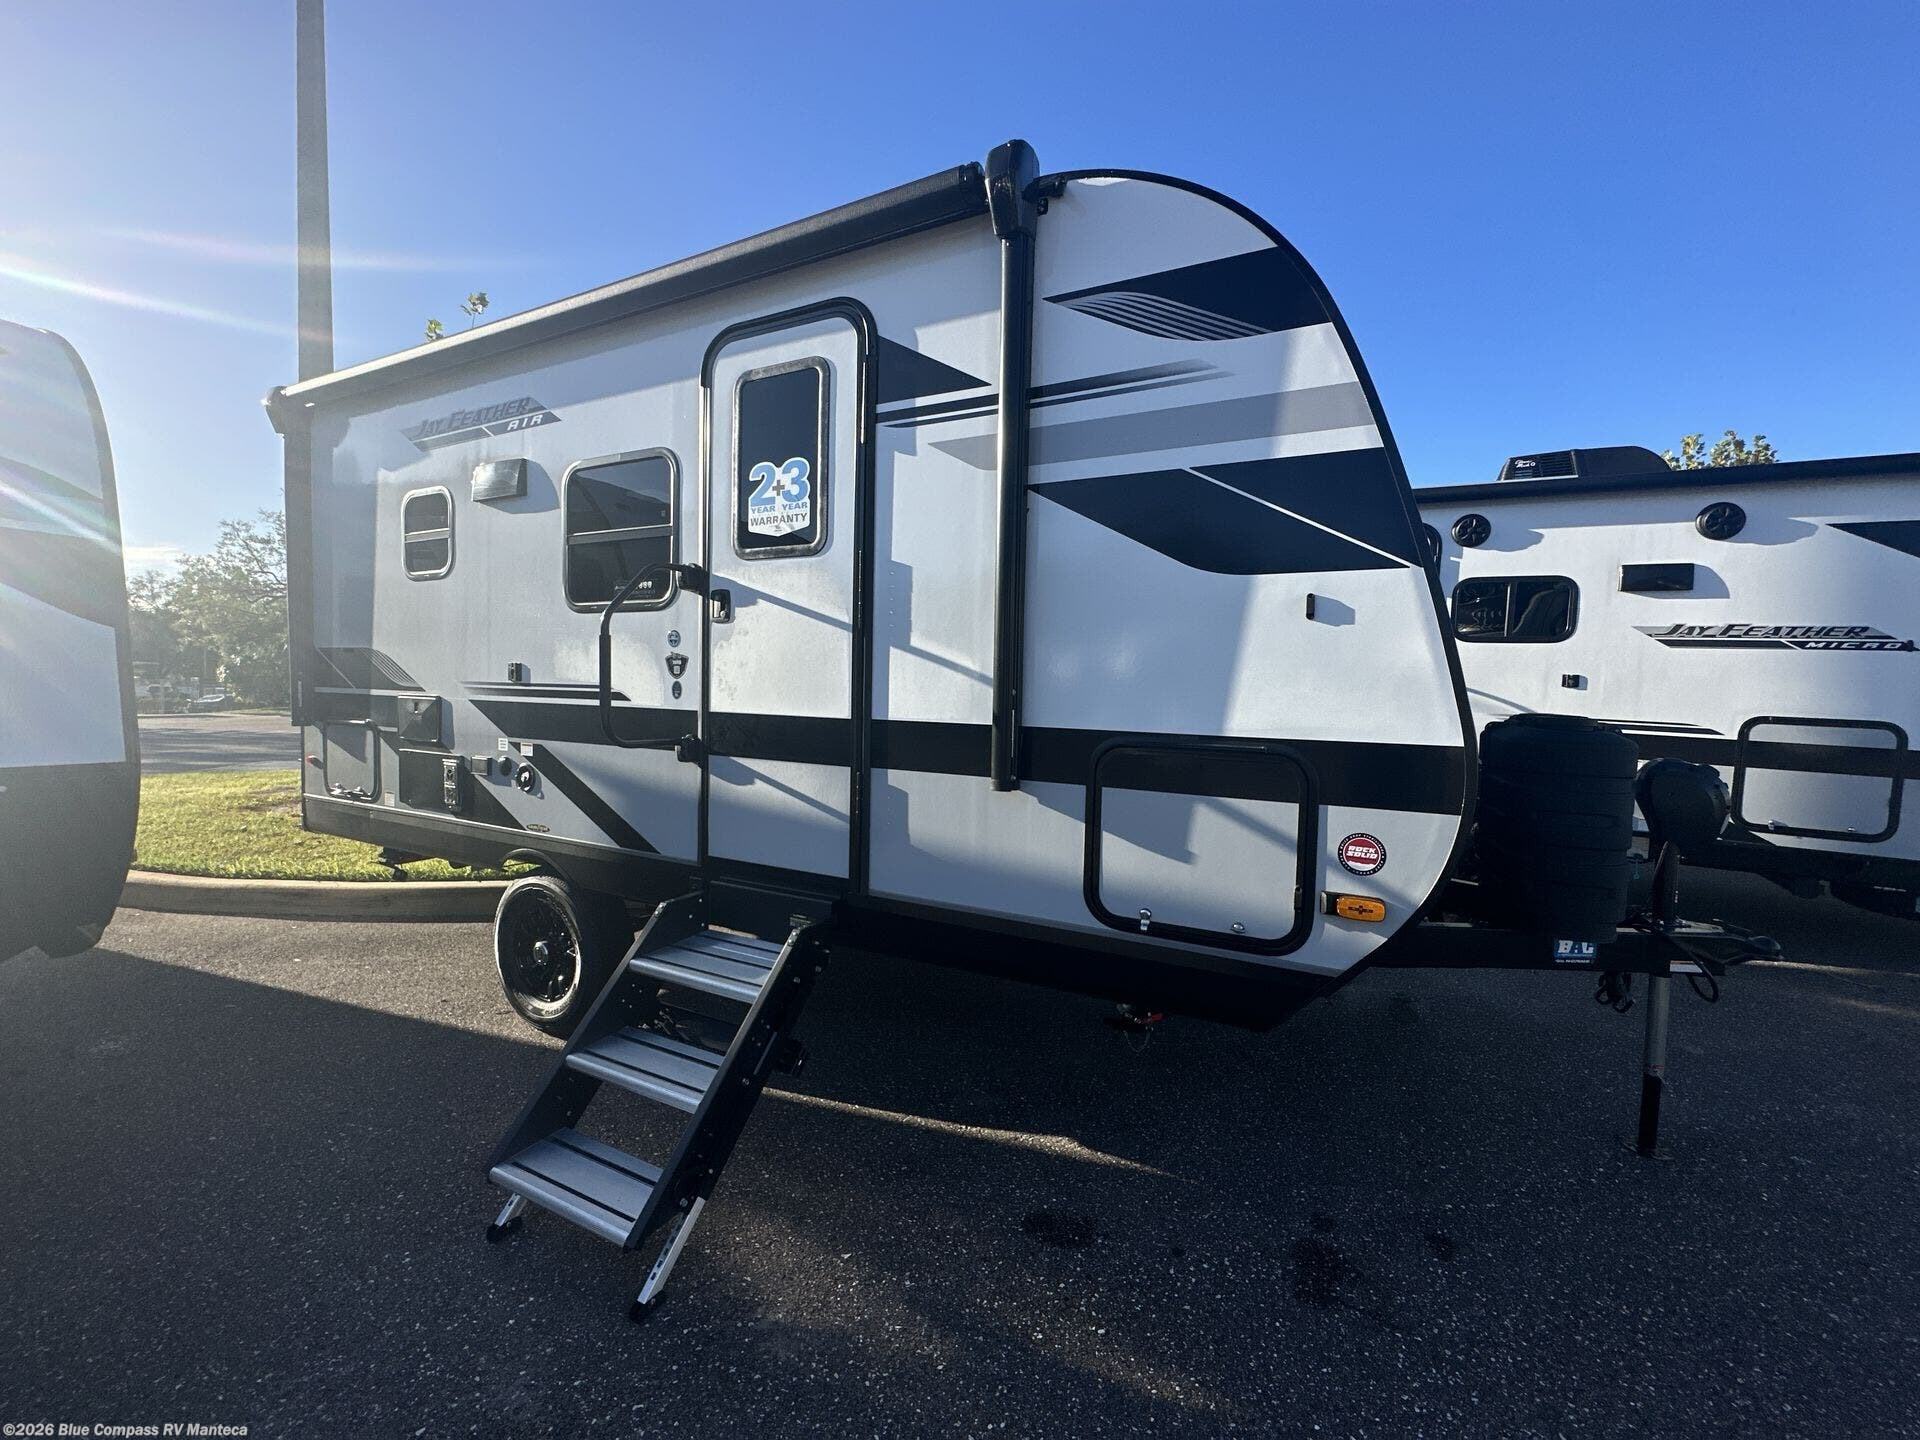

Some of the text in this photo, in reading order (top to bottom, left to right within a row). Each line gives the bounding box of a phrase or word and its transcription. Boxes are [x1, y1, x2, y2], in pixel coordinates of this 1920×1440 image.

[507, 414, 544, 431] AIR
[751, 501, 808, 514] YEAR YEAR
[750, 512, 808, 527] WARRANTY
[1803, 641, 1902, 649] MICRO
[1345, 850, 1378, 860] SOLID
[1347, 845, 1377, 854] ROCK
